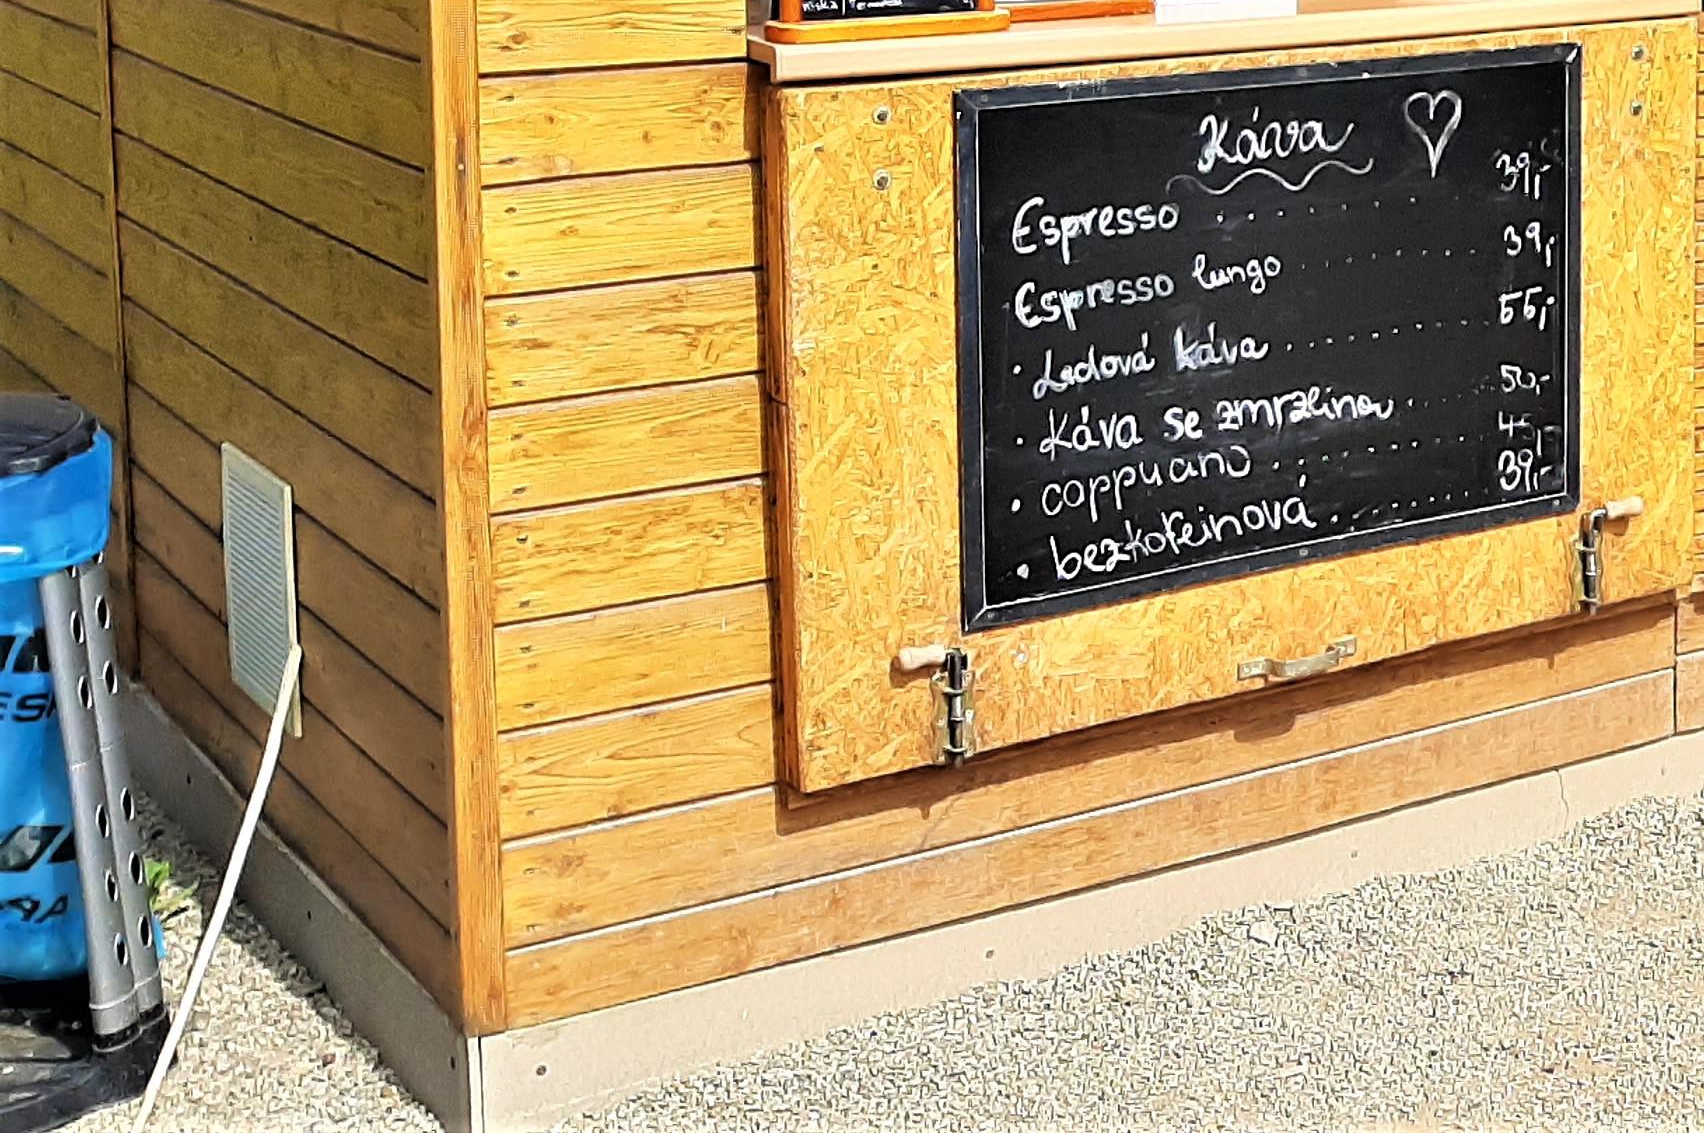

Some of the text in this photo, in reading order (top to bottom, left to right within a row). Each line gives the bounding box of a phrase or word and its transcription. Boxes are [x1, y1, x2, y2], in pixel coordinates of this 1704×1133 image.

[1197, 107, 1355, 173] Káva
[1012, 196, 1180, 265] Espresso
[1014, 274, 1175, 331] Espresso
[1191, 254, 1282, 295] lungo
[1174, 322, 1270, 372] káva
[1039, 405, 1144, 462] Káva
[1162, 405, 1203, 442] se
